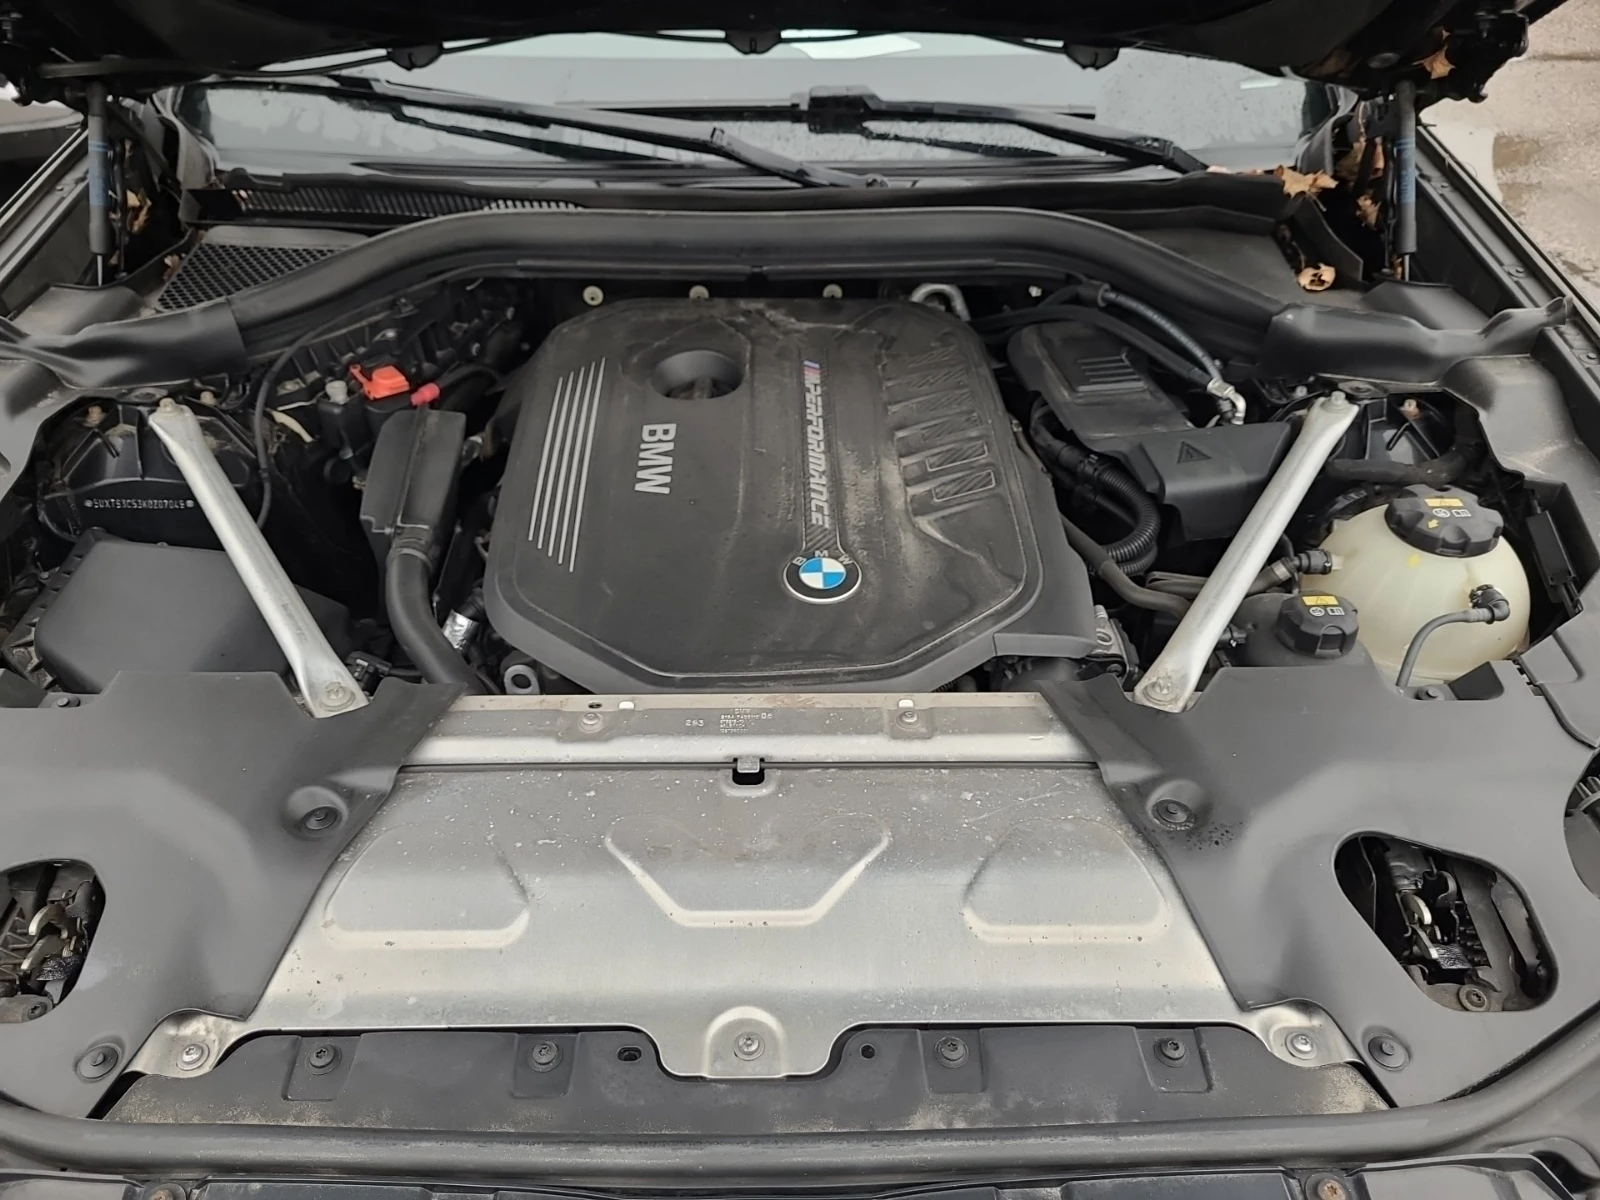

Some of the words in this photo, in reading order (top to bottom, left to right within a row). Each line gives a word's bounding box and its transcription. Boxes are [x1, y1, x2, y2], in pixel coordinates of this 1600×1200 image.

[634, 423, 677, 494] BMW
[805, 383, 829, 528] PERFORMANCE
[792, 550, 853, 566] BMW
